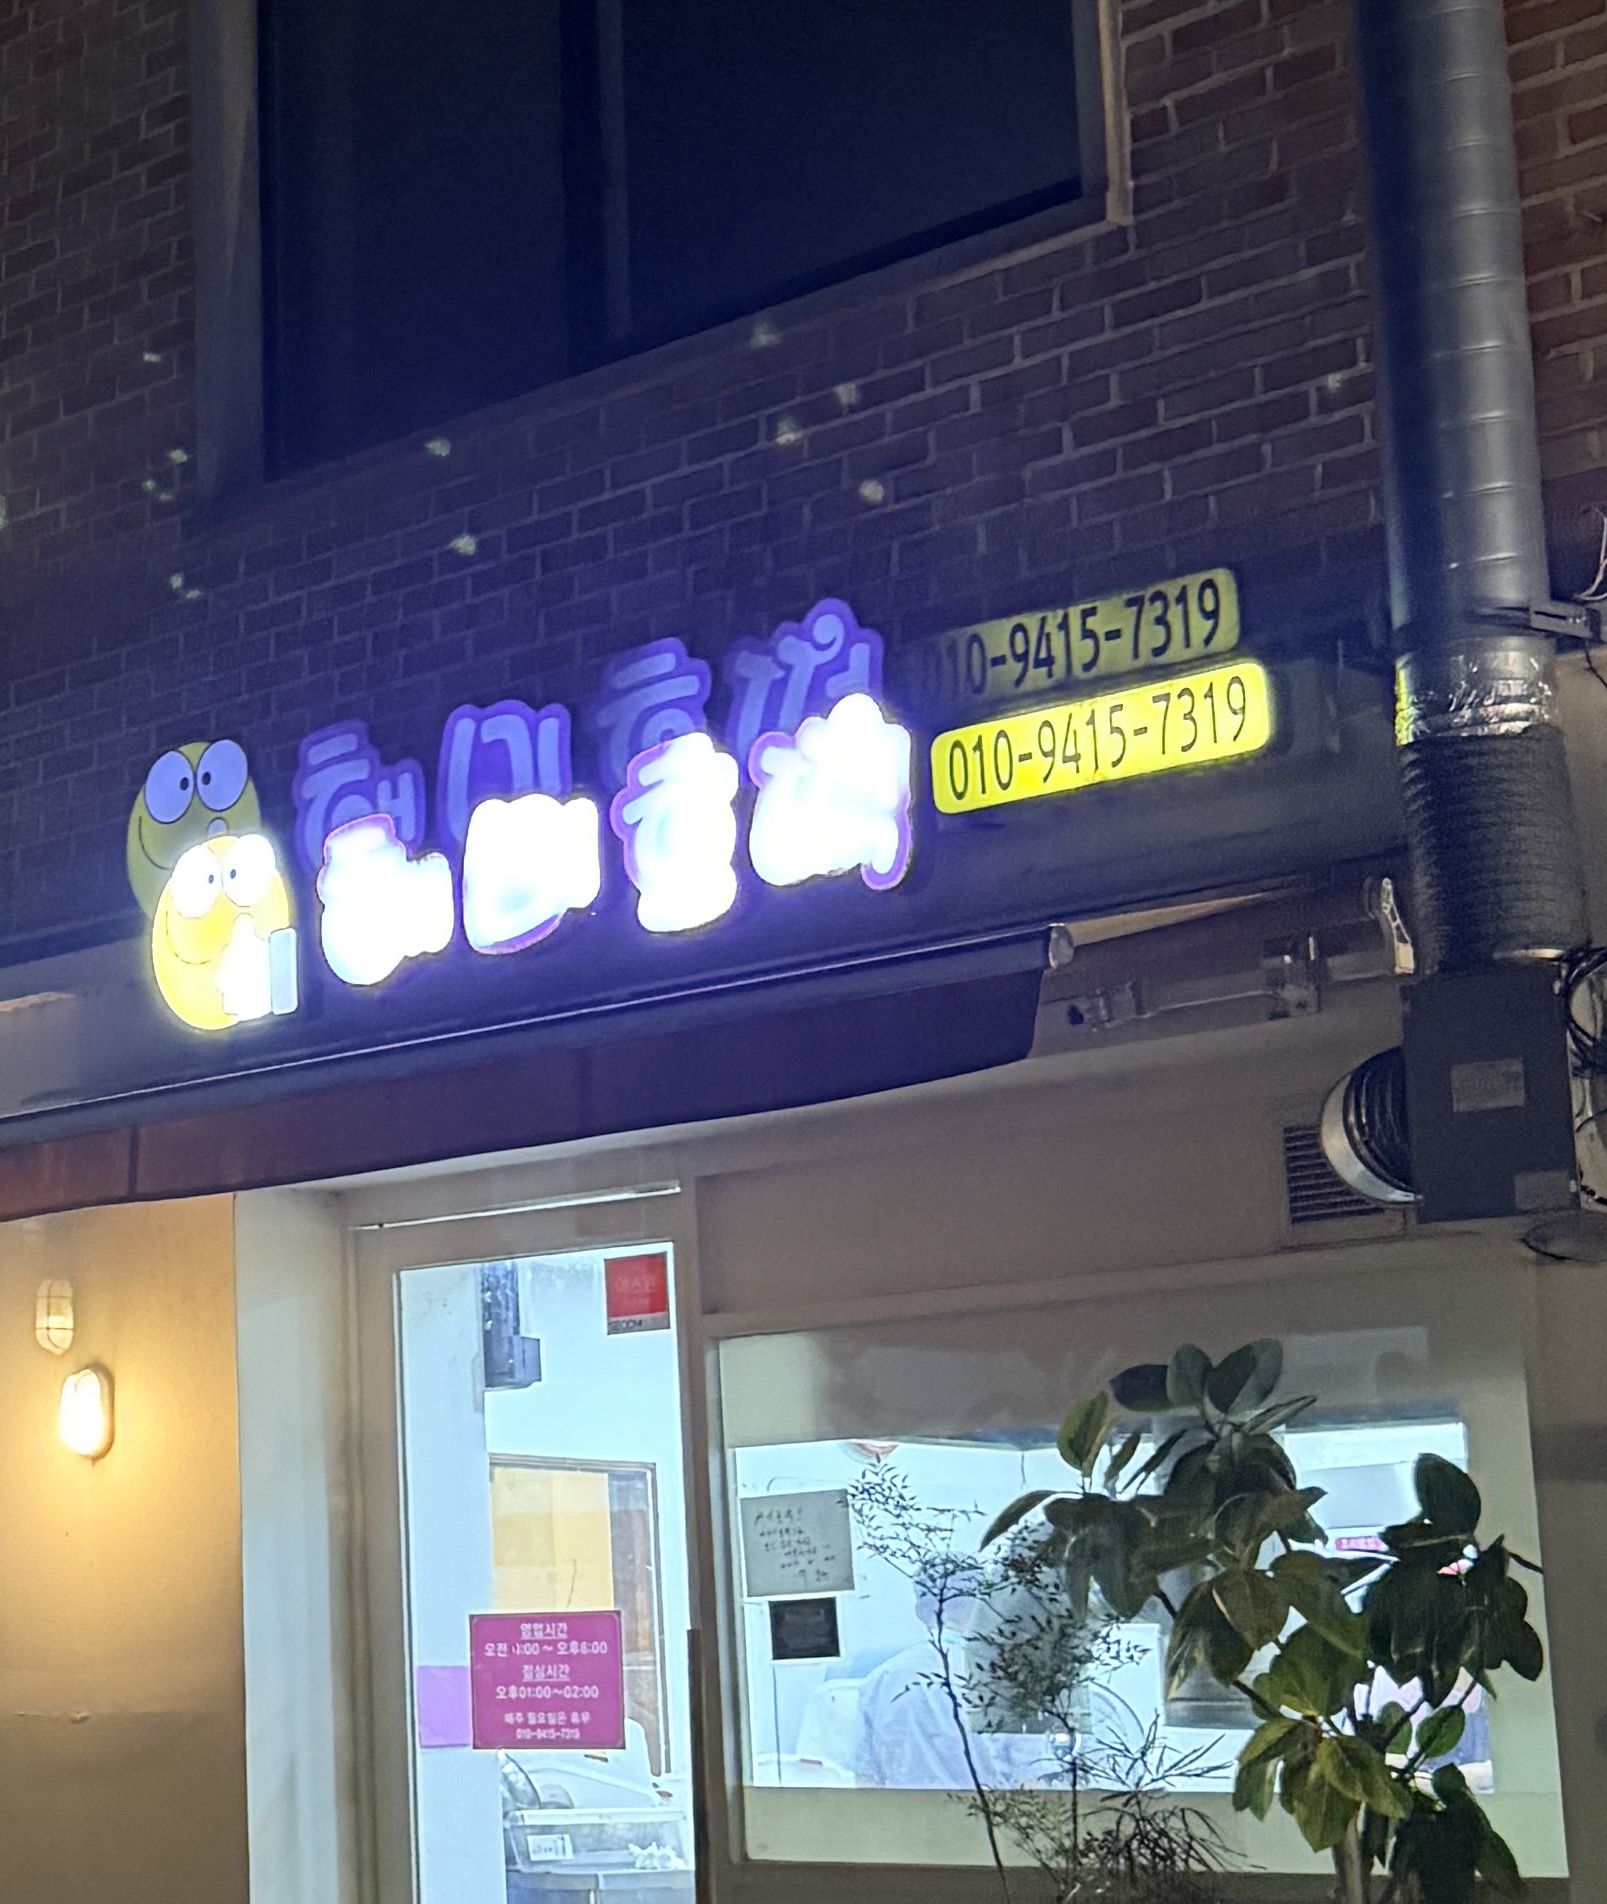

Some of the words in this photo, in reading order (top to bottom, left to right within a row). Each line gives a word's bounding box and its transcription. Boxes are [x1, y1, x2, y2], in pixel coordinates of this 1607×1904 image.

[938, 577, 1221, 695] 10-9415-7319
[949, 676, 1247, 801] 010-9415-7319
[520, 1622, 568, 1638] 영업시간
[484, 1643, 508, 1657] 오전
[522, 1664, 570, 1681] 점심시간
